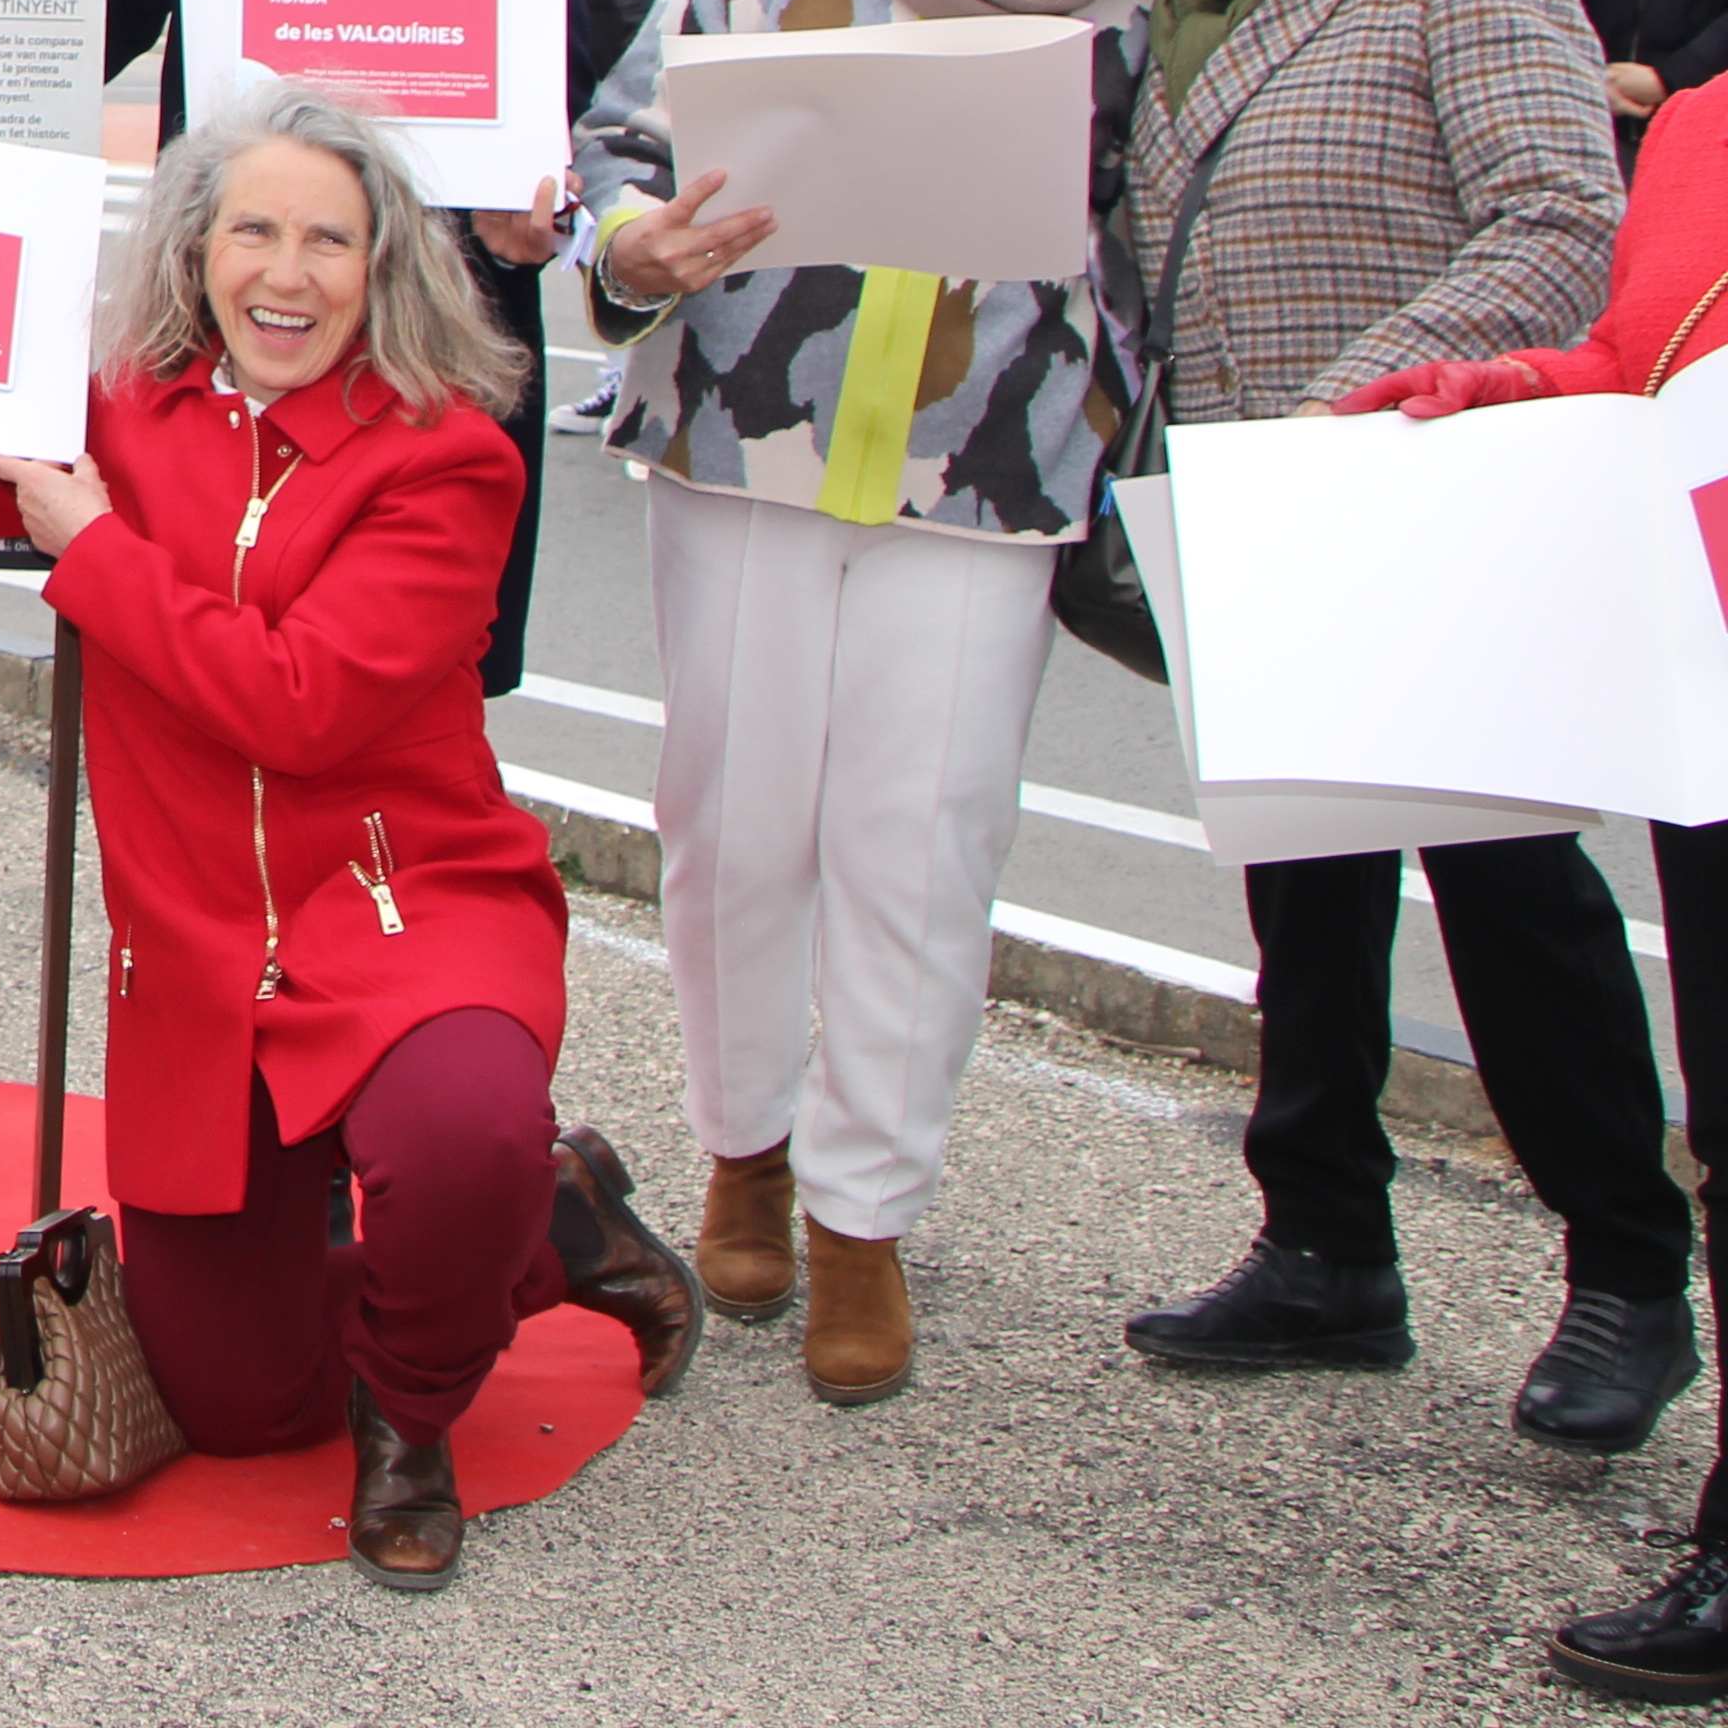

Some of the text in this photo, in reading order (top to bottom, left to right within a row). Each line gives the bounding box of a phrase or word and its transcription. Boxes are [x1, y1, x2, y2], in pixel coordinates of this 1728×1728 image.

[275, 21, 464, 44] de les VALQUÍRIES
[15, 34, 25, 45] la
[28, 37, 84, 48] comparsa
[16, 51, 36, 59] van
[39, 51, 79, 60] marcar
[3, 62, 13, 72] la
[16, 63, 59, 75] primera
[29, 115, 42, 125] de
[9, 128, 25, 139] fet
